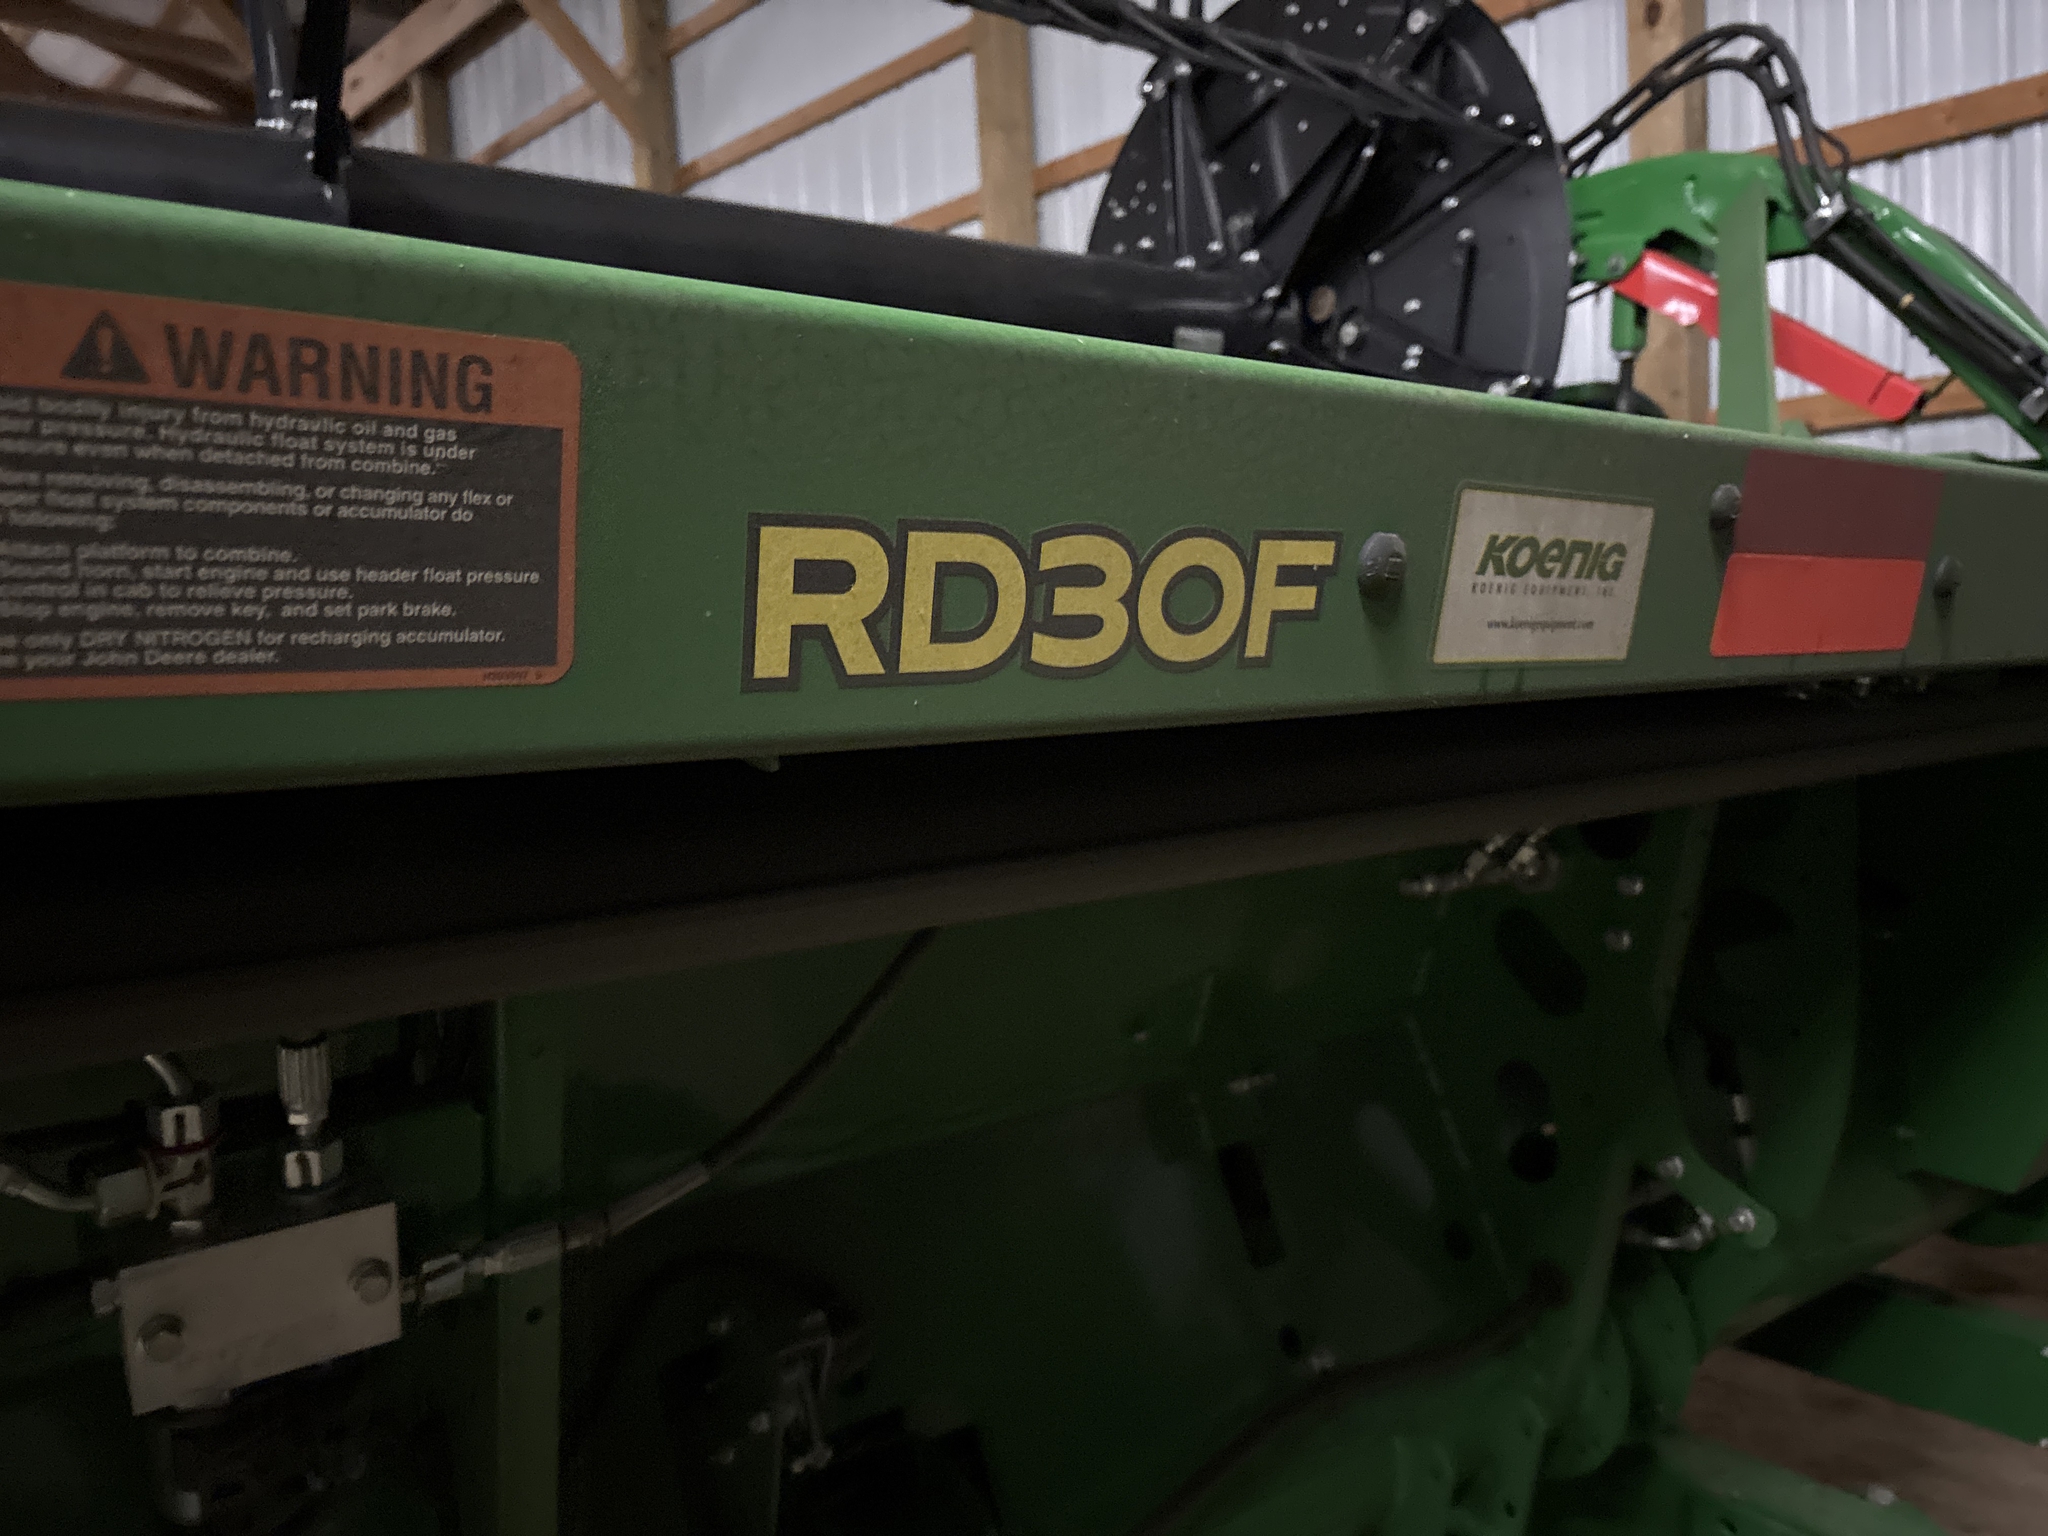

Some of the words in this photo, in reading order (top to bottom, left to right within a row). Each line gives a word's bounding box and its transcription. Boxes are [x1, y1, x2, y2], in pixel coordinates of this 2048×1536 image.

[163, 322, 494, 415] WARNING
[117, 402, 186, 427] injury
[191, 406, 244, 427] from
[249, 410, 346, 434] hydraulic
[351, 419, 377, 437] oil
[383, 423, 418, 440] and
[423, 426, 457, 444] gas
[157, 425, 265, 448] Hydraulic
[270, 432, 318, 450] float
[323, 440, 395, 458] system
[400, 444, 417, 458] is
[422, 447, 477, 463] under
[133, 446, 195, 463] when
[198, 447, 296, 468] detached
[301, 453, 346, 471] from
[350, 457, 438, 477] combine.
[314, 485, 335, 499] or
[339, 484, 423, 505] changing
[427, 490, 459, 507] any
[462, 489, 492, 505] flex
[495, 494, 514, 507] or
[99, 495, 181, 514] system
[182, 498, 309, 518] components
[313, 503, 333, 518] or
[337, 502, 448, 523] accumulator
[451, 508, 474, 523] do
[77, 544, 172, 566] platform
[174, 546, 199, 561] to
[202, 547, 298, 564] combine.
[142, 563, 195, 580] start
[197, 565, 269, 584] engine
[273, 565, 312, 582] and
[316, 566, 350, 582] use
[355, 564, 419, 583] header
[422, 566, 463, 584] float
[466, 569, 540, 587] pressure
[112, 583, 155, 599] cab
[157, 583, 182, 599] to
[185, 582, 257, 599] relieve
[261, 585, 355, 602] pressure.
[1471, 582, 1517, 595] KOENIG
[146, 602, 227, 618] remove
[280, 600, 319, 618] and
[322, 602, 352, 618] set
[356, 601, 399, 621] park
[402, 601, 457, 618] brake.
[745, 516, 1341, 690] RD30F
[78, 629, 129, 647] DRY
[133, 629, 252, 648] NITROGEN
[255, 630, 286, 646] for
[289, 628, 393, 648] recharging
[395, 627, 506, 645] accumulator.
[82, 651, 139, 667] John
[143, 649, 208, 666] Deere
[211, 648, 280, 665] dealer.
